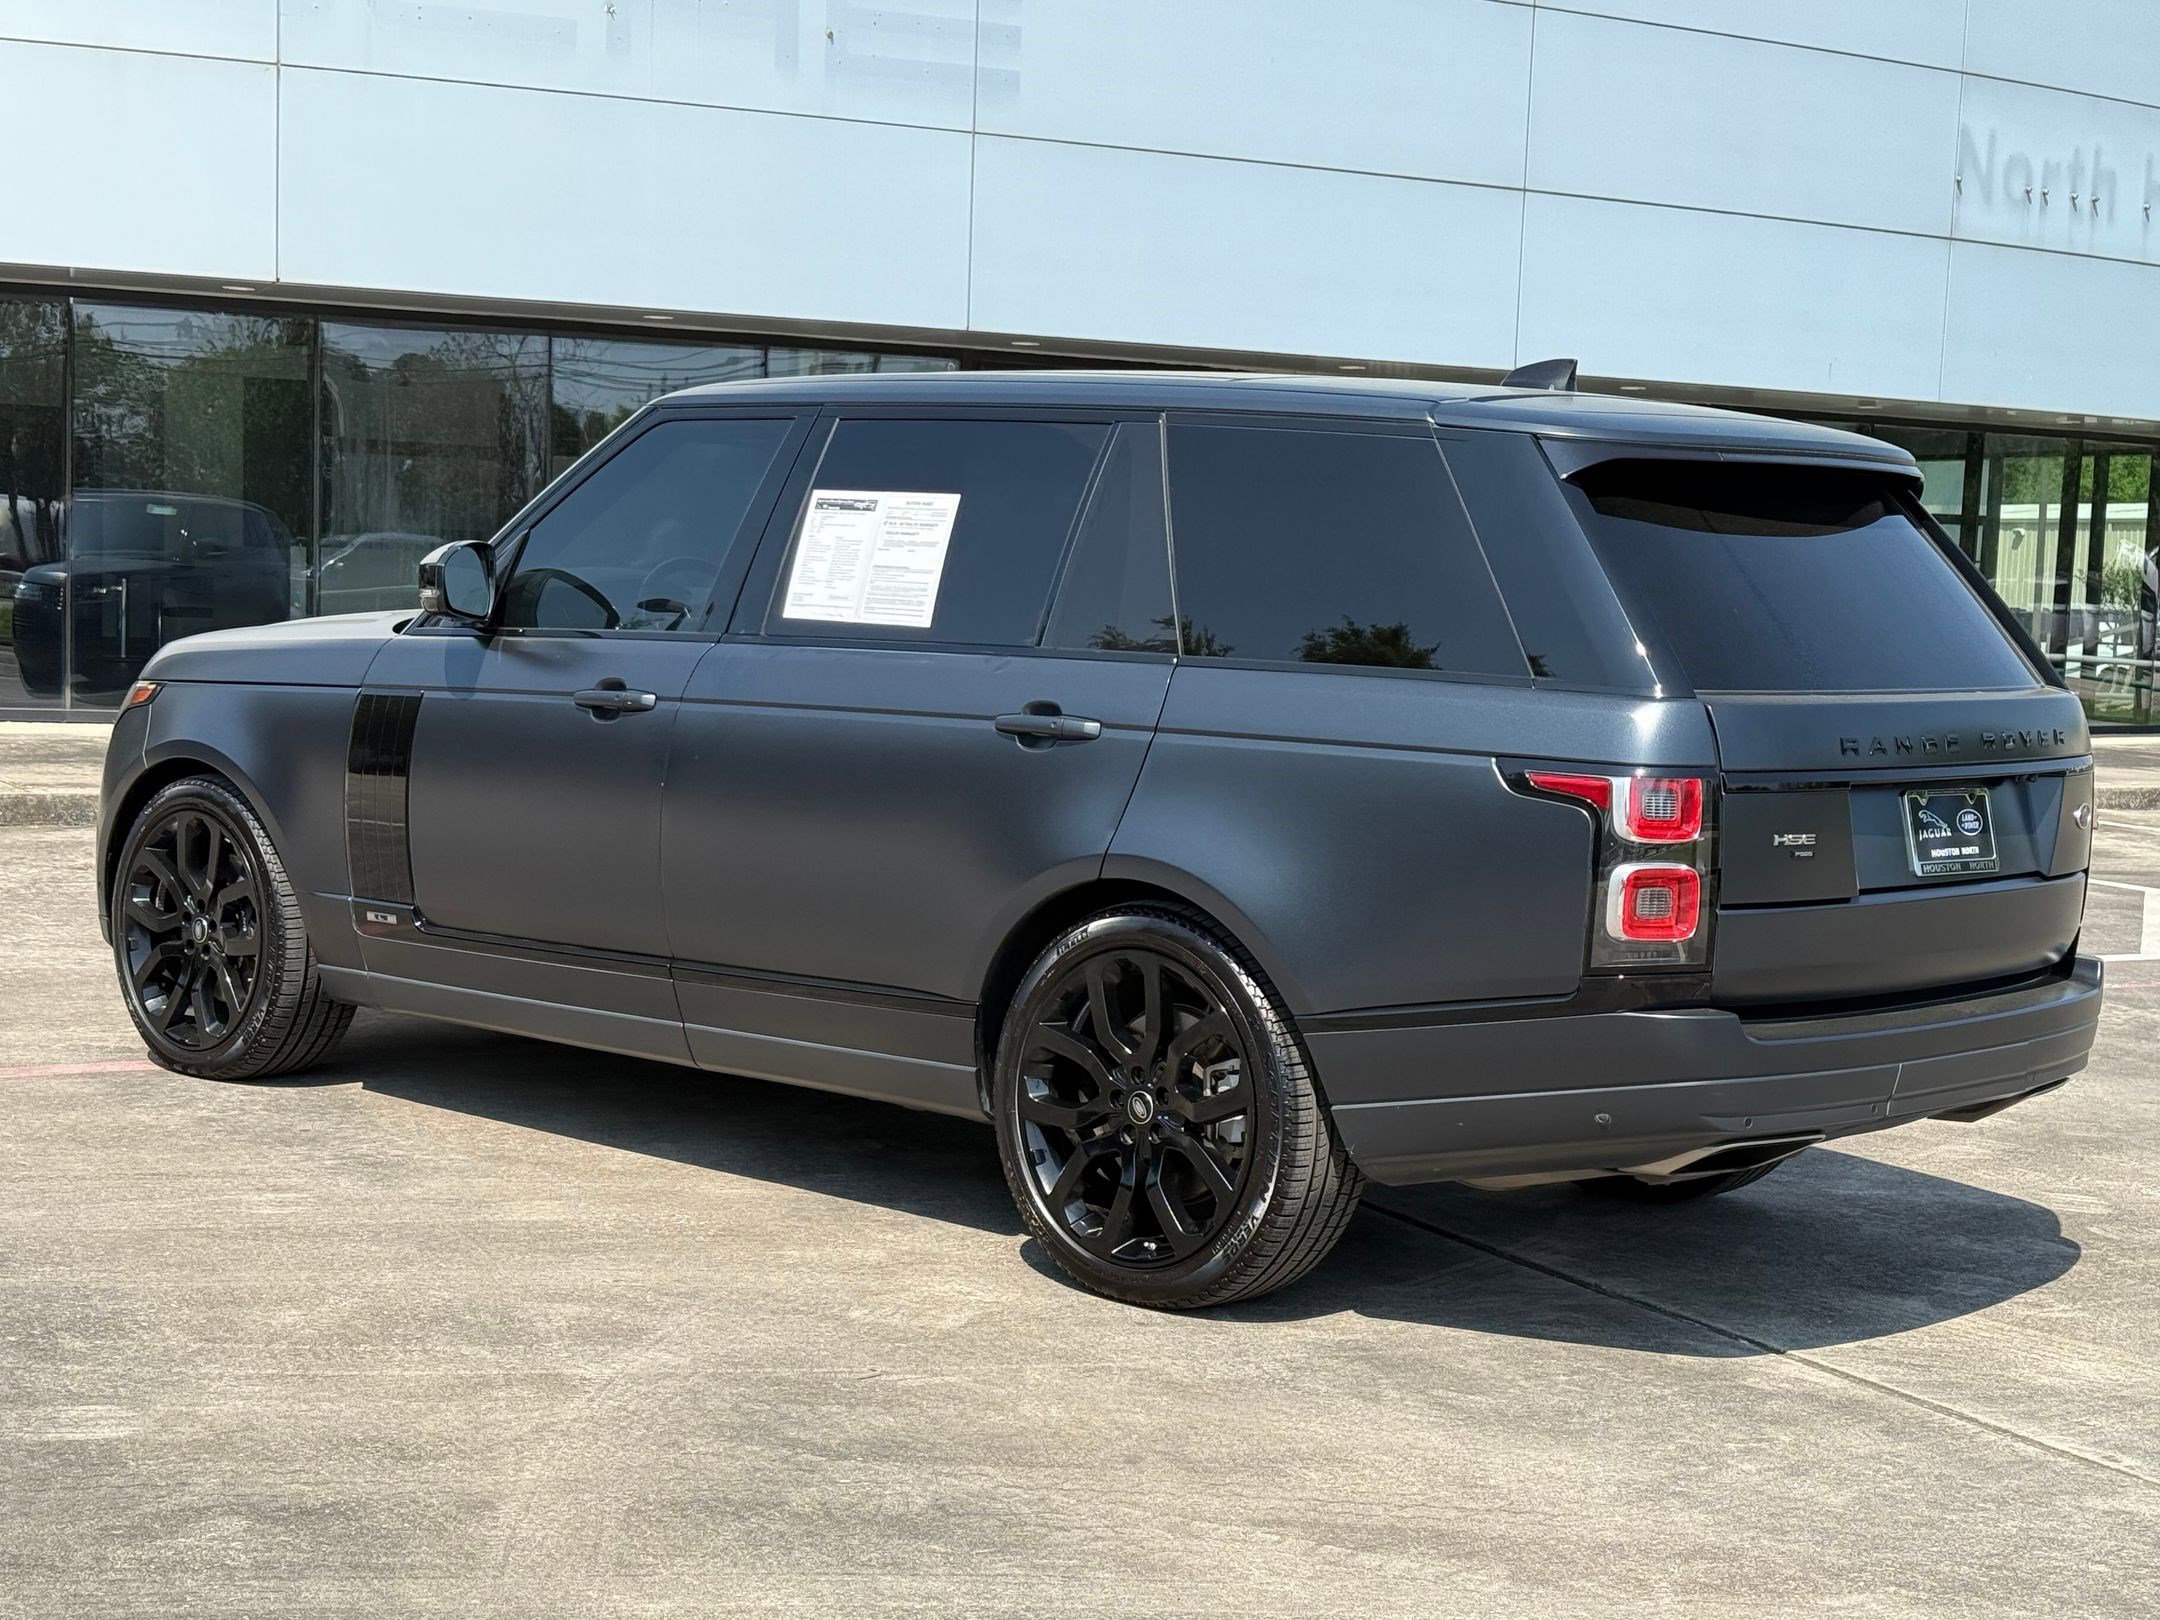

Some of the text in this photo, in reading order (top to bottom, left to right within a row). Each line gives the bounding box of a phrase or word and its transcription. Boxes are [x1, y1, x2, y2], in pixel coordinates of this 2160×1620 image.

[1956, 122, 2117, 227] North
[1840, 727, 2066, 756] RANGE ROVER
[1773, 833, 1817, 846] HSE
[1919, 827, 1952, 841] JAGUAR
[1931, 846, 1979, 857] HOUSTON NORTH
[1923, 861, 1994, 873] HOUSTON NORTH
